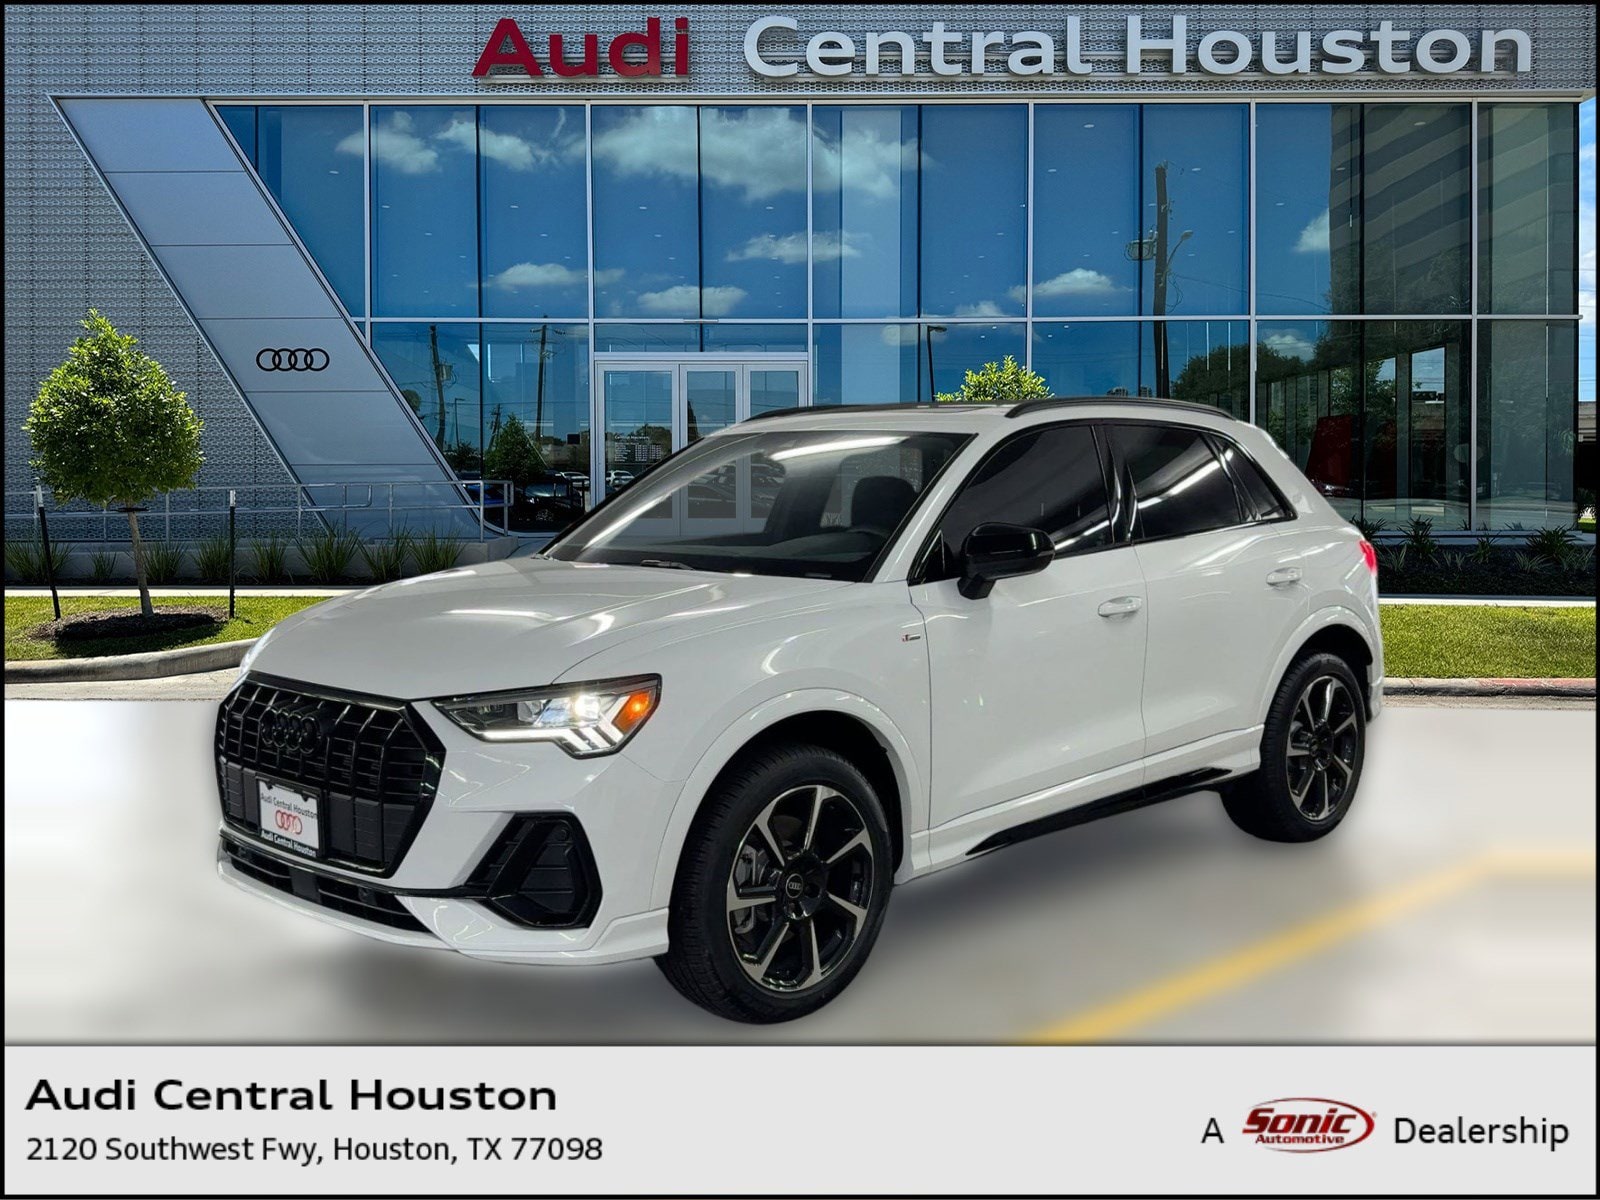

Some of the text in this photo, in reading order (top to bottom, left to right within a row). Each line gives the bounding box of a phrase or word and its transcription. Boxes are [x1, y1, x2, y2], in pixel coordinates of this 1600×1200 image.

[473, 14, 1533, 78] Audi Central Houston
[260, 792, 318, 819] Audi Central Houston
[261, 829, 317, 858] Audi Central Houston
